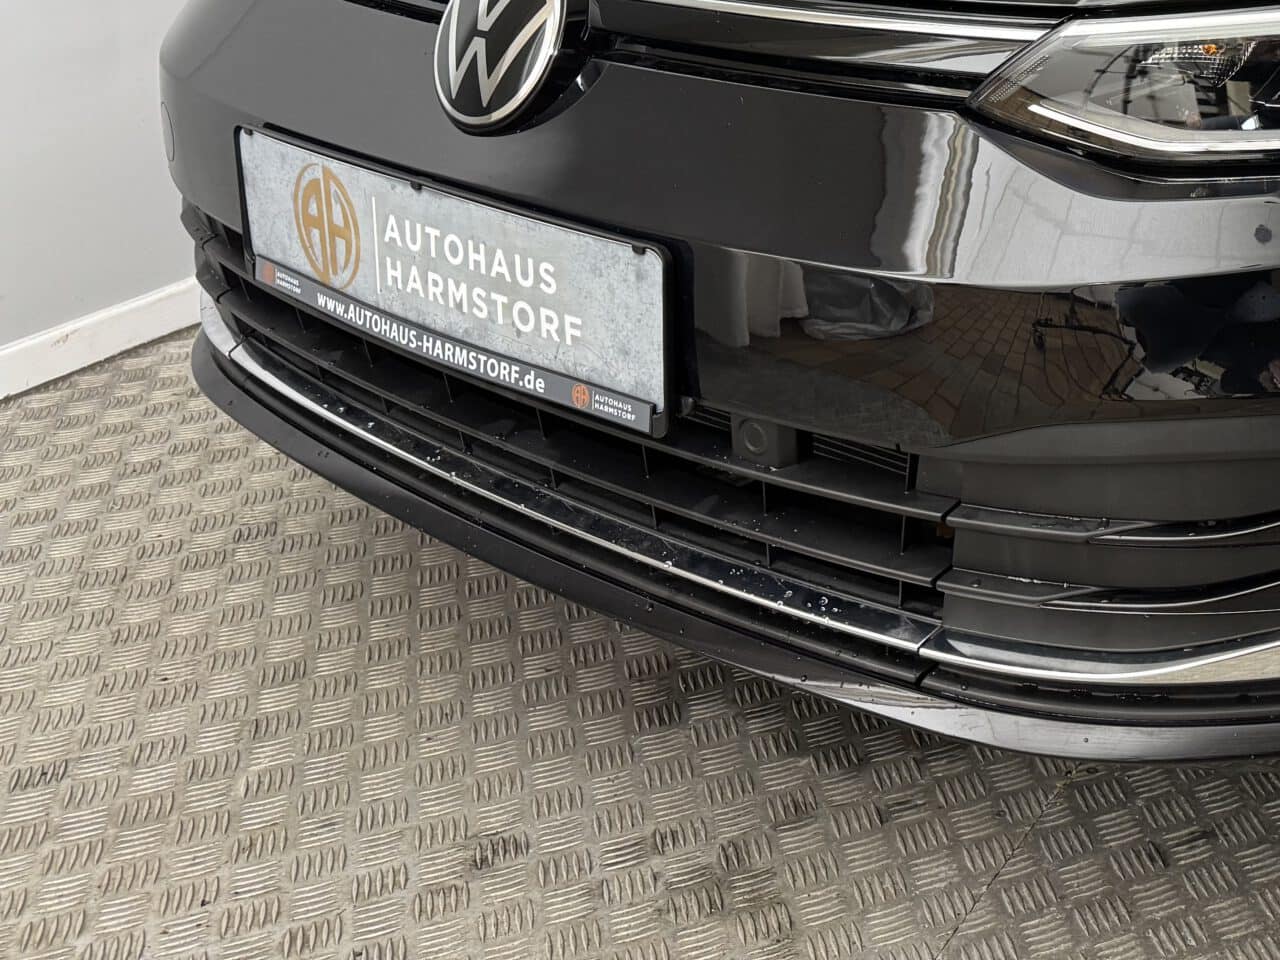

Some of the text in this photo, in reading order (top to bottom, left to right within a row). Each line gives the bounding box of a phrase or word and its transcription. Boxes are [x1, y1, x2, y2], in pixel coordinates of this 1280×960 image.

[384, 214, 557, 295] AUTOHAUS
[386, 256, 583, 345] HARMSTORF
[317, 292, 545, 394] www.AUTOHAUS-HARMSTORF.de
[594, 394, 632, 412] AUTOHAUS
[594, 403, 636, 421] HARMSTORF
